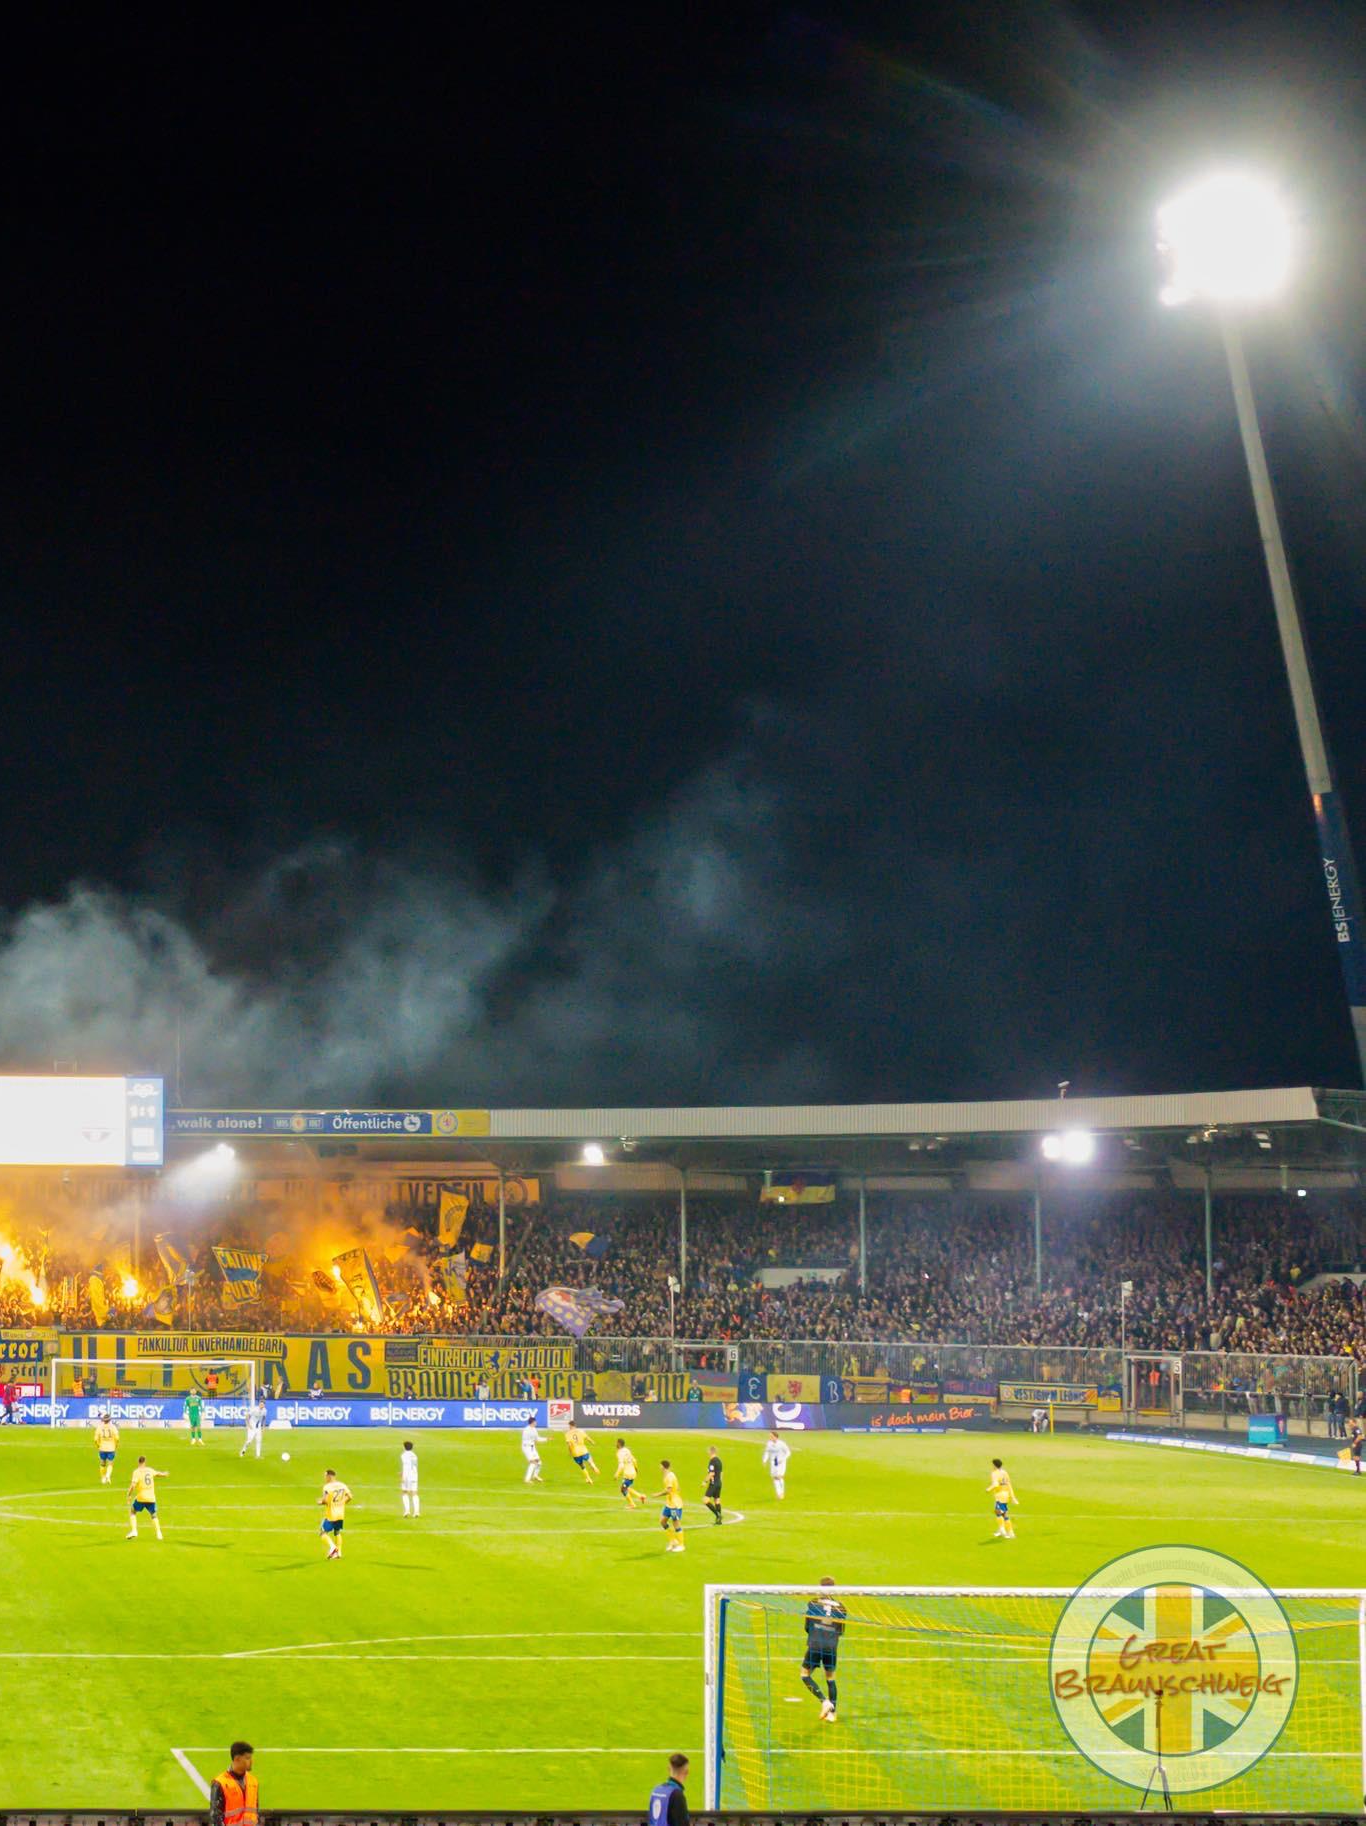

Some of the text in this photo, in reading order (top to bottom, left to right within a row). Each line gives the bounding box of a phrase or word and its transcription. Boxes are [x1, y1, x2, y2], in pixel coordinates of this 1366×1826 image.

[216, 1116, 263, 1129] alone!
[332, 1116, 402, 1130] Öffentliche
[137, 1336, 284, 1354] FANKULTUR UNVERHANDELBAR!
[420, 1348, 483, 1368] EINTRACHT
[508, 1348, 572, 1369] STADION
[581, 1404, 641, 1417] WOLTERS
[602, 1418, 620, 1428] 1627
[887, 1411, 914, 1427] doch
[144, 1473, 152, 1486] 6
